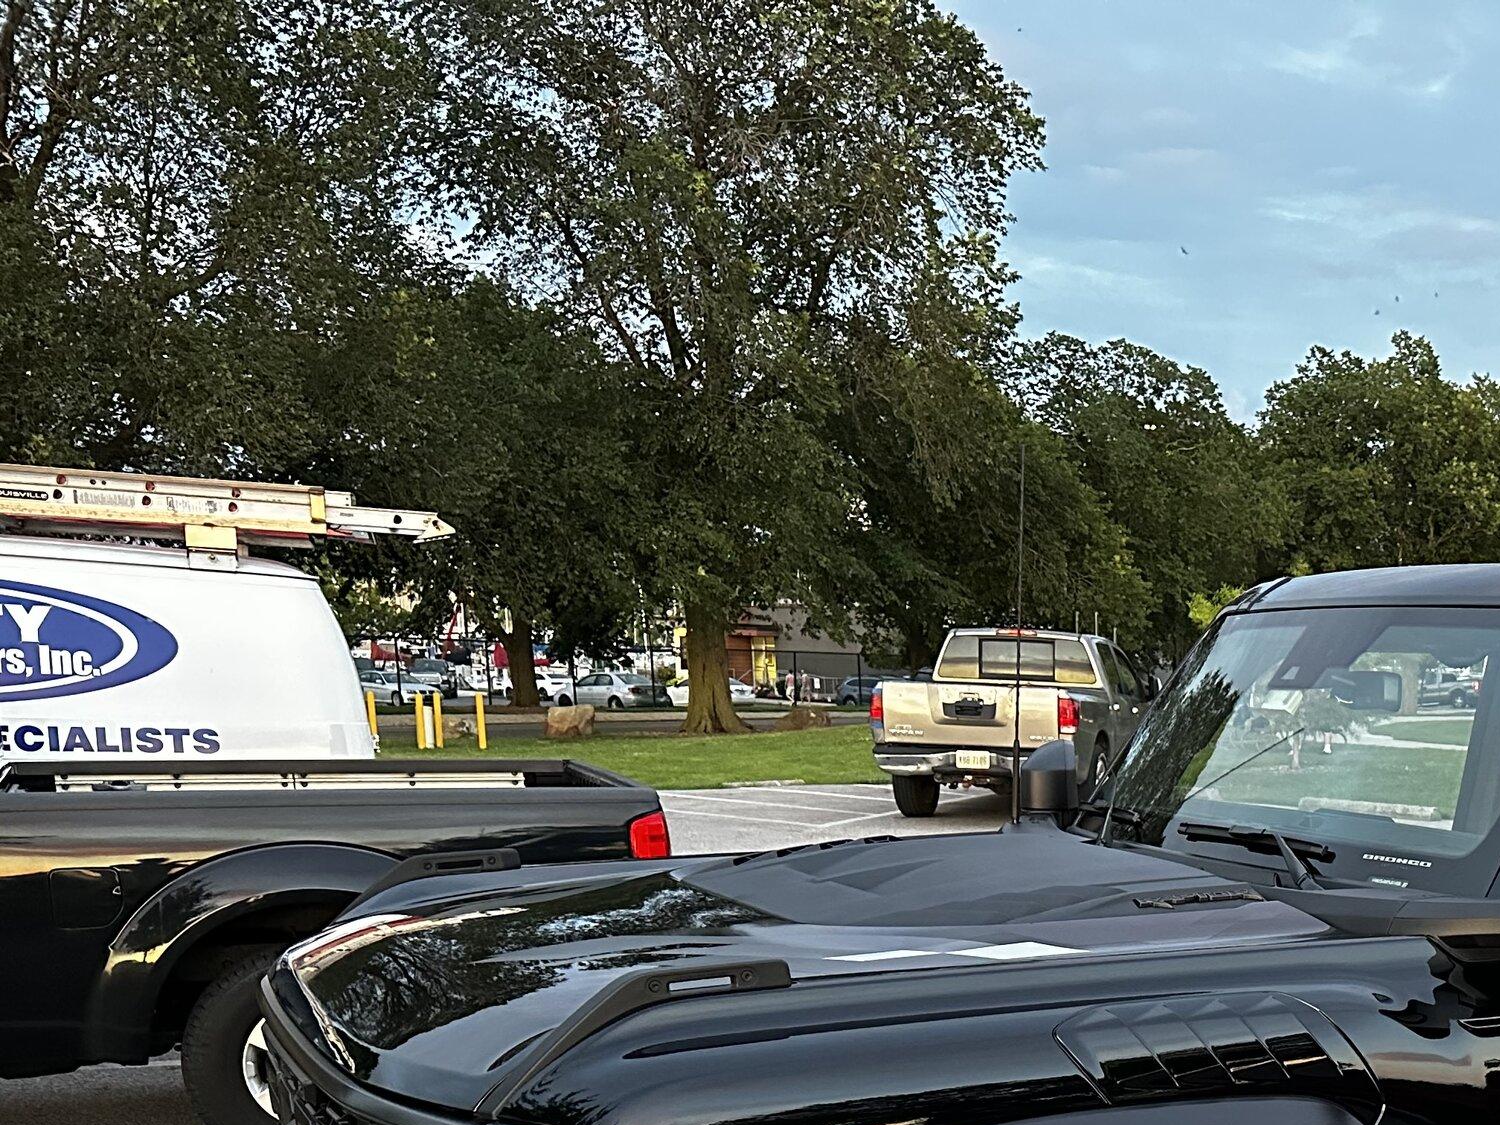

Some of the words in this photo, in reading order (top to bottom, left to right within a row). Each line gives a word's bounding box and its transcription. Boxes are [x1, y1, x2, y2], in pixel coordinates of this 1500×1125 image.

[0, 489, 47, 499] UISVILLE
[0, 603, 52, 642] Y
[38, 644, 102, 676] Inc.
[1362, 853, 1433, 868] BRONCO
